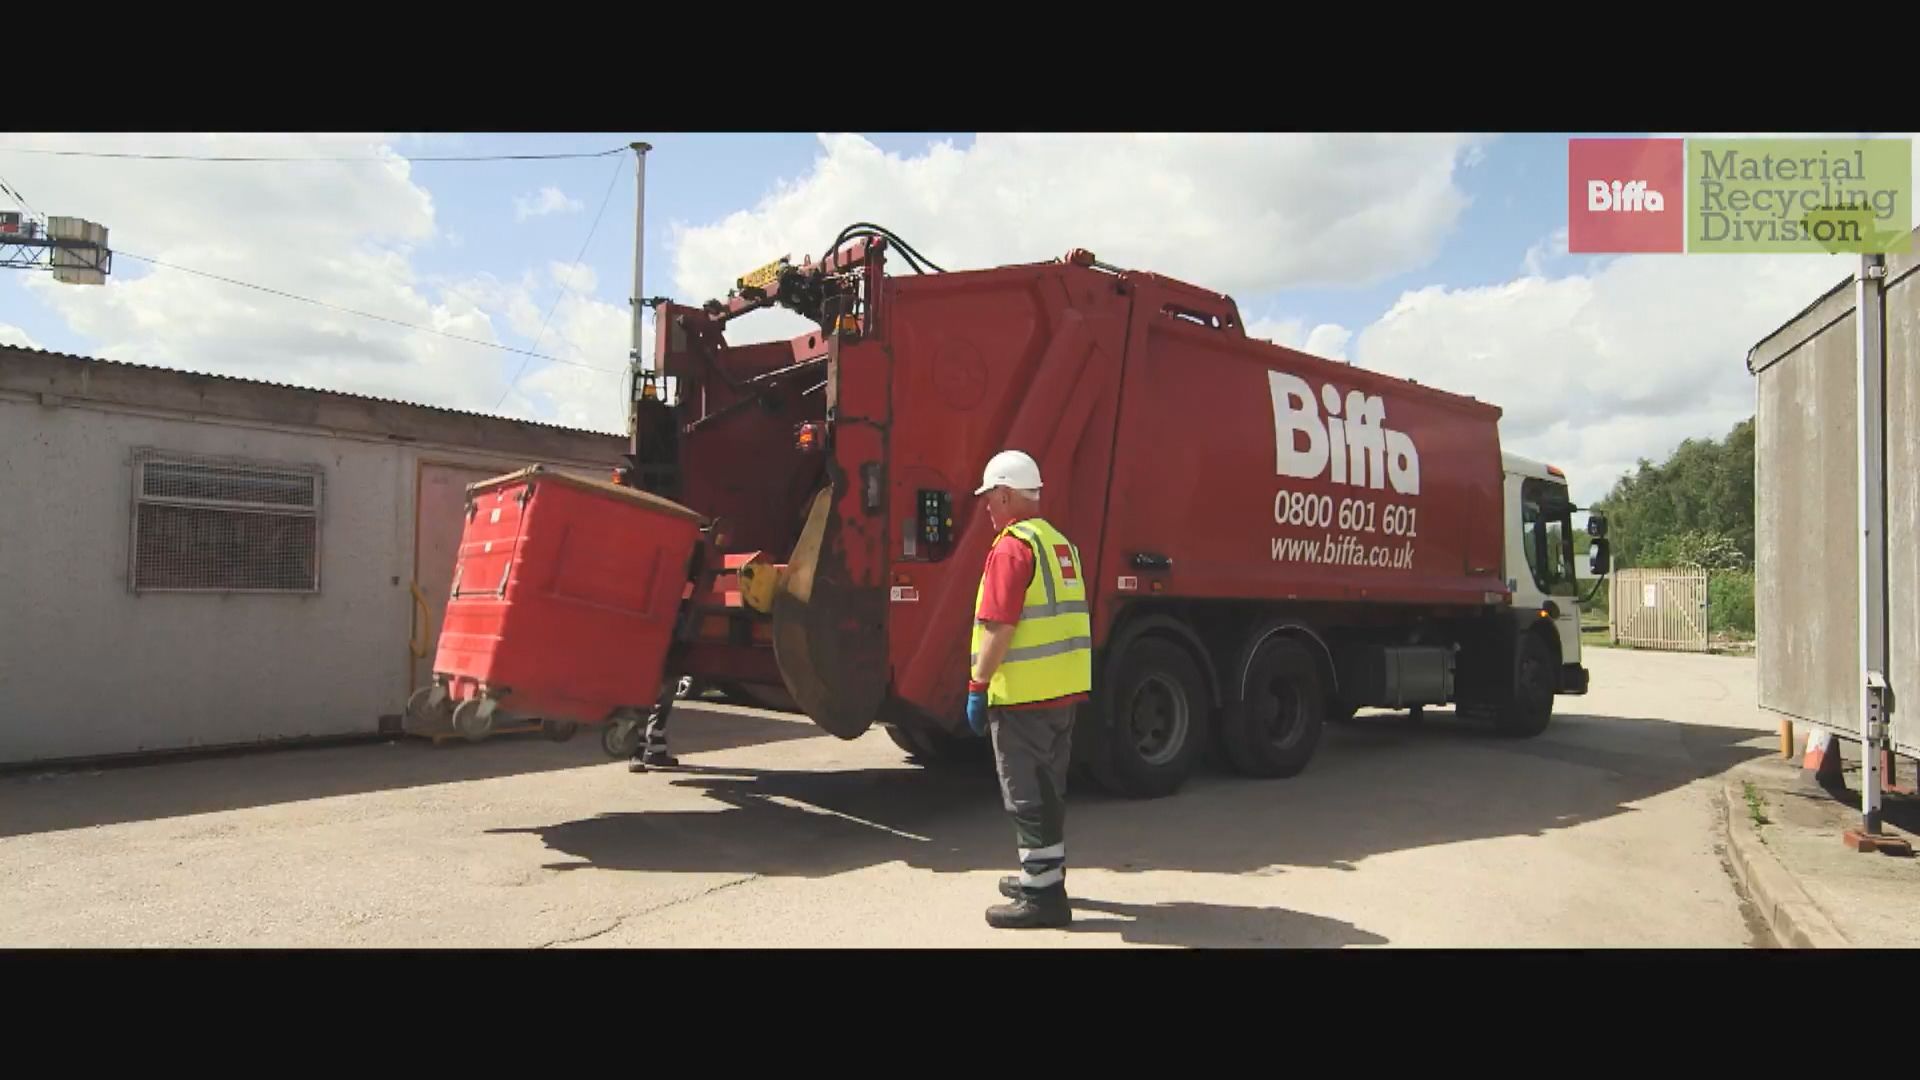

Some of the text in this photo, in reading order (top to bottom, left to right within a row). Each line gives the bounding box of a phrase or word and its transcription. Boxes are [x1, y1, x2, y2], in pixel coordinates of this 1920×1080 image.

[1268, 370, 1420, 495] Biffa
[1274, 490, 1417, 537] 0800 601 601
[1271, 534, 1414, 569] www.biffa.co.uk
